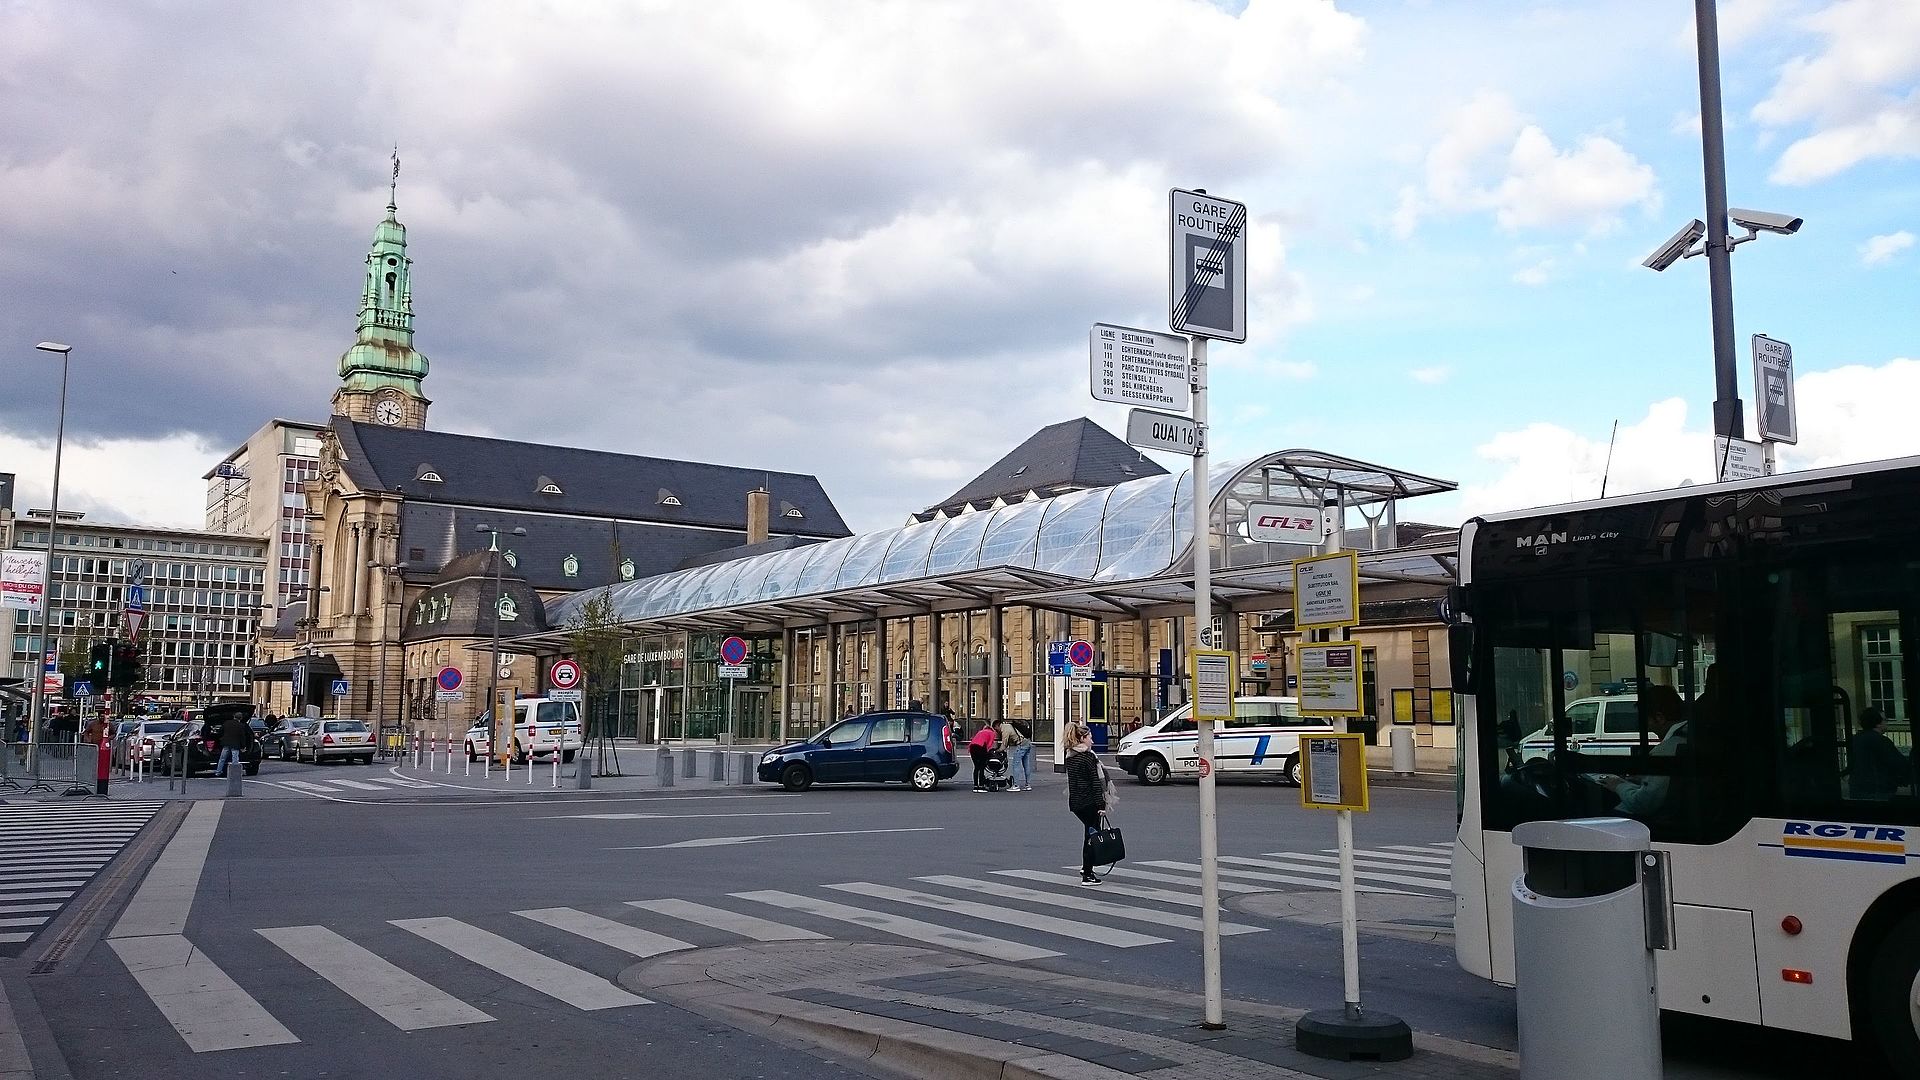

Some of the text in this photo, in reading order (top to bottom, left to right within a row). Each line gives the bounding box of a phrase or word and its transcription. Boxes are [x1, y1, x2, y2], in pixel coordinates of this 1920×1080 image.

[1192, 201, 1227, 219] GARE
[1100, 329, 1154, 345] LIGNE DESTINATION
[1103, 342, 1185, 363] 110 ECHTERNACH (route directe)
[1764, 343, 1782, 356] GARE
[1104, 351, 1113, 360] 111
[1121, 354, 1154, 366] ECHTERNACH
[1154, 359, 1164, 368] (via
[1121, 363, 1135, 372] PARC
[1103, 369, 1114, 378] 750
[1121, 372, 1148, 383] STEINSEL
[1103, 387, 1114, 395] 975
[1121, 381, 1132, 389] BGL
[1133, 382, 1164, 394] KIRCHBERG
[1152, 422, 1194, 445] QUAI 16
[1516, 531, 1619, 548] MAN Lion's City
[623, 648, 684, 665] GARE DE LUXEMBOURG
[1783, 821, 1906, 842] RGTR
